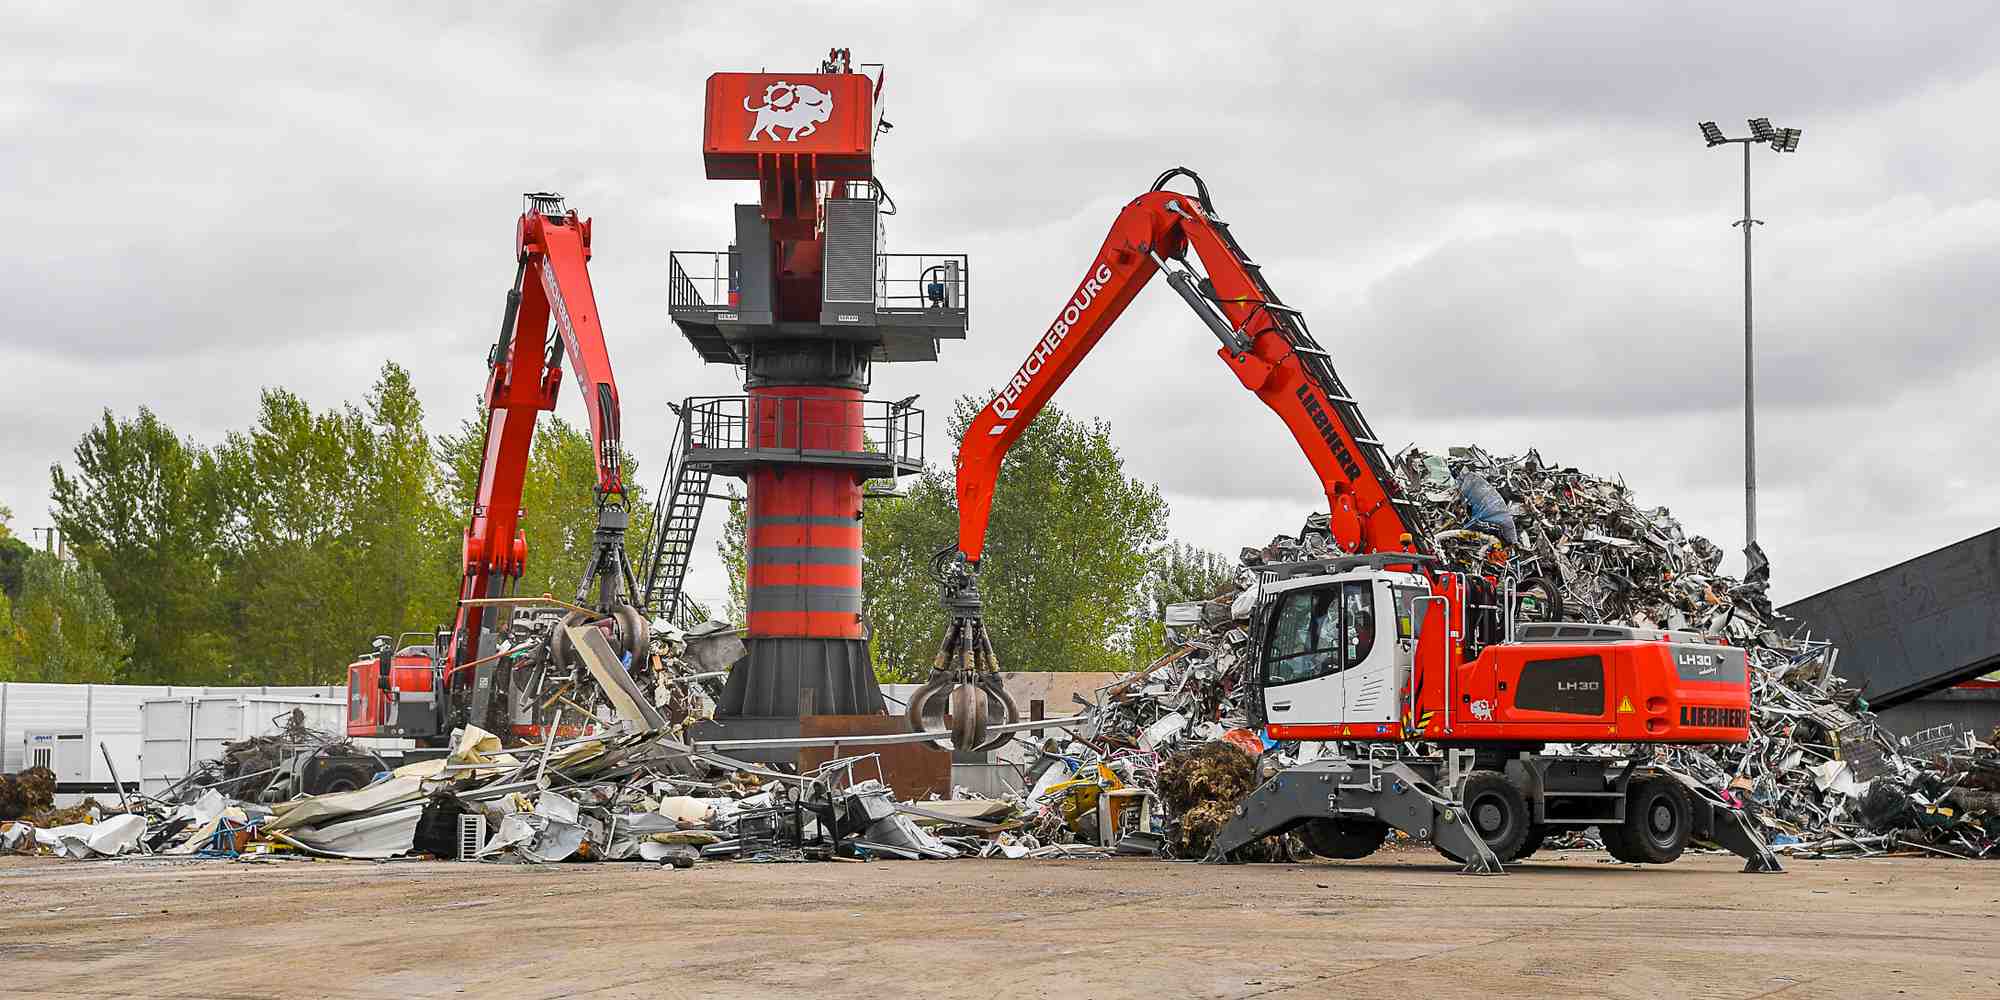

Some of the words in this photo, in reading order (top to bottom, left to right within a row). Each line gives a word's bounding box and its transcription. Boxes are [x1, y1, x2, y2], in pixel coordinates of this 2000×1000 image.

[992, 264, 1112, 417] DERICHEBOURG
[1296, 383, 1361, 483] LIEBHERR
[1680, 654, 1712, 666] LH30
[1558, 681, 1599, 690] LH30
[1680, 705, 1747, 728] LIEBHERR
